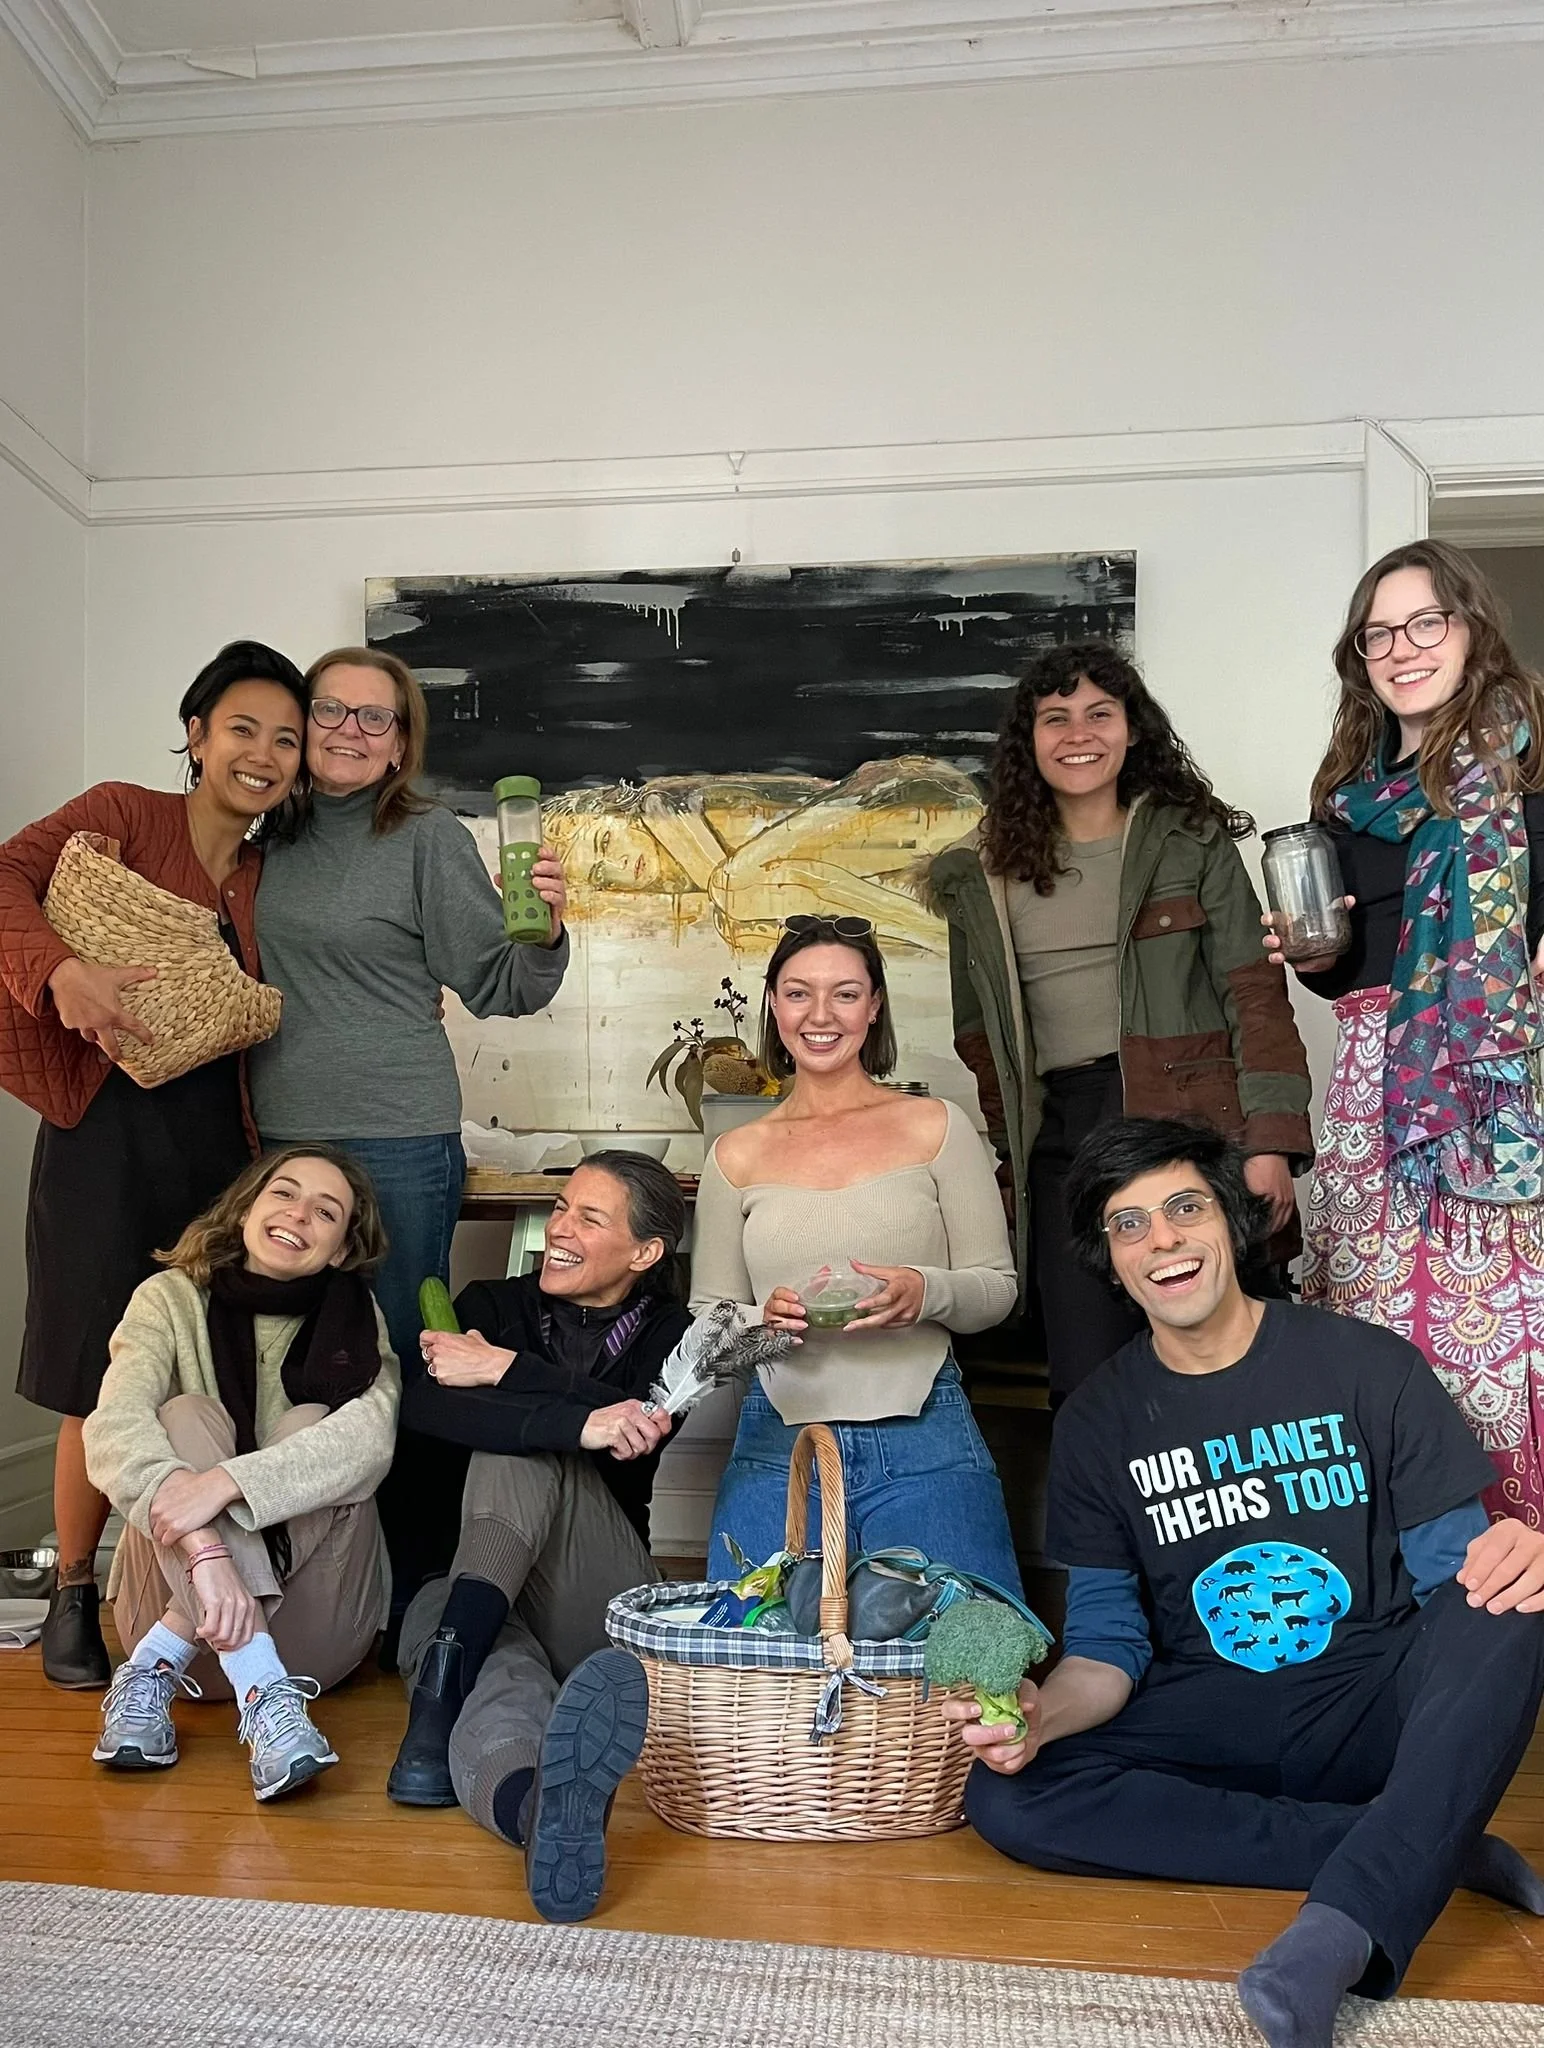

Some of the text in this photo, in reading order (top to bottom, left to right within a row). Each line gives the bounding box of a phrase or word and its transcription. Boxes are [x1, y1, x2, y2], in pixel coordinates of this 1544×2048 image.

[1129, 1413, 1356, 1498] OUR PLANET,
[1145, 1461, 1368, 1545] THEIRS TOO!
